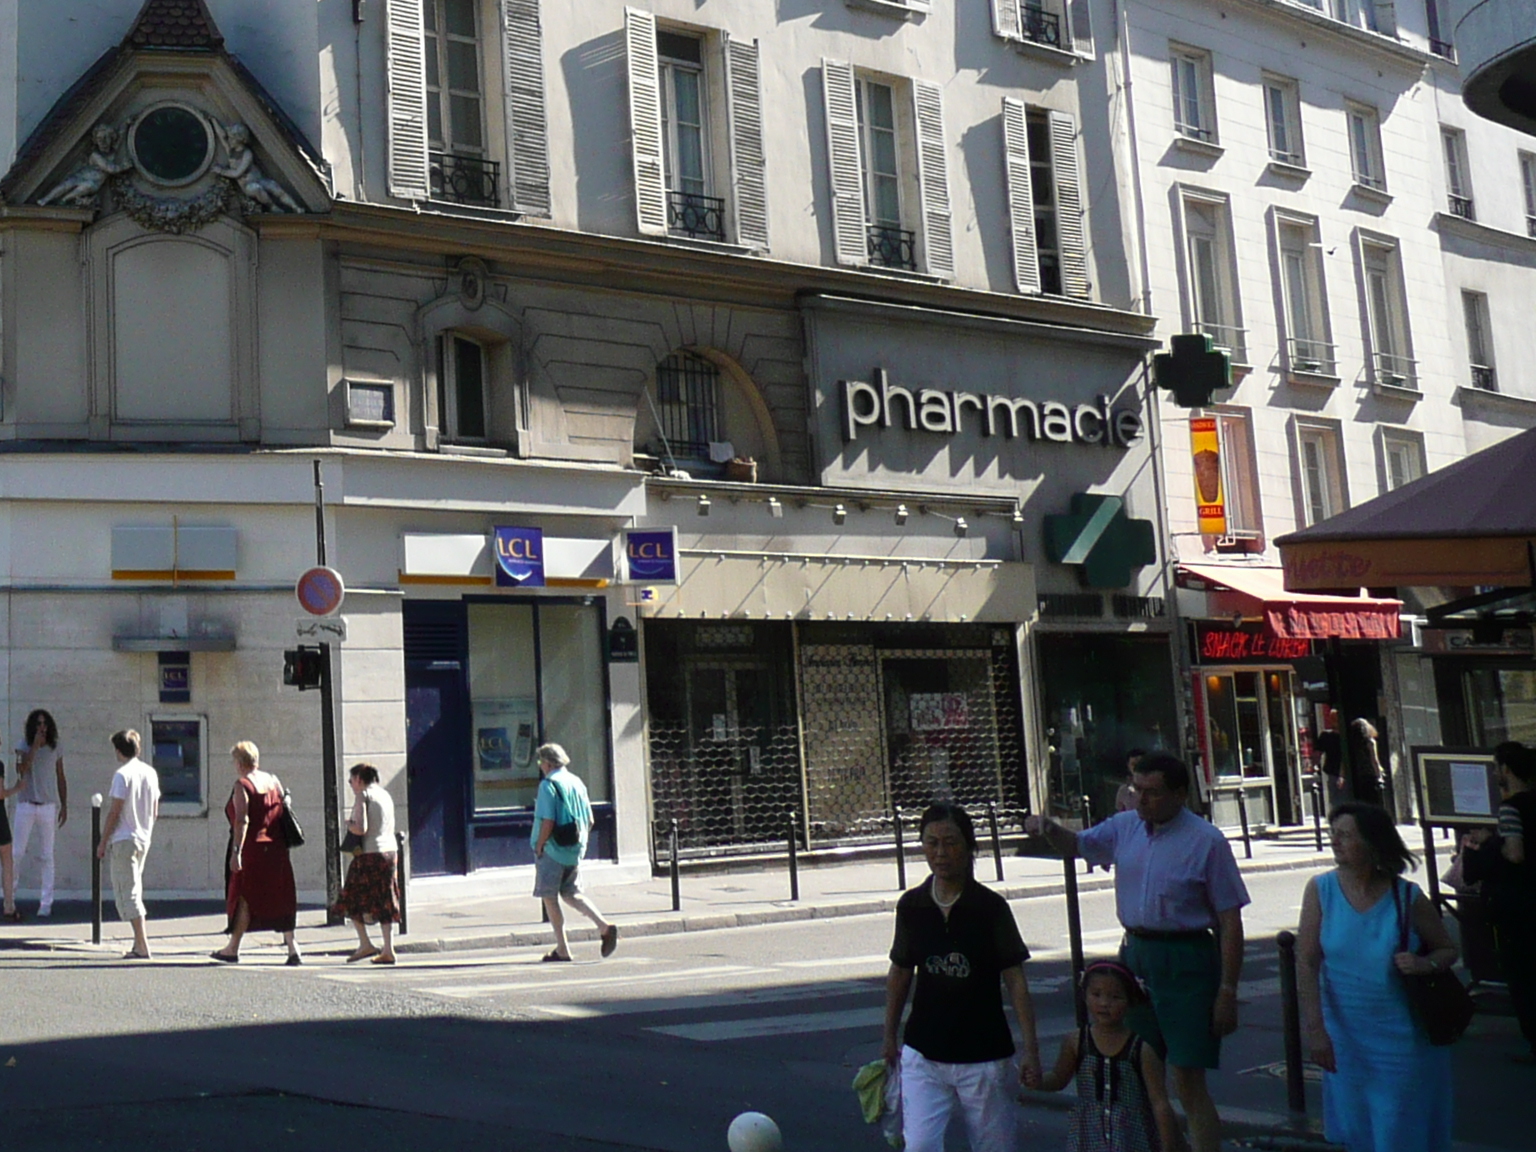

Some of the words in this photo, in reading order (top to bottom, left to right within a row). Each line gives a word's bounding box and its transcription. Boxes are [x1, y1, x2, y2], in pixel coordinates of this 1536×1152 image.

[838, 367, 1146, 448] pharmacie
[497, 537, 538, 559] LCL
[628, 542, 669, 559] LCL
